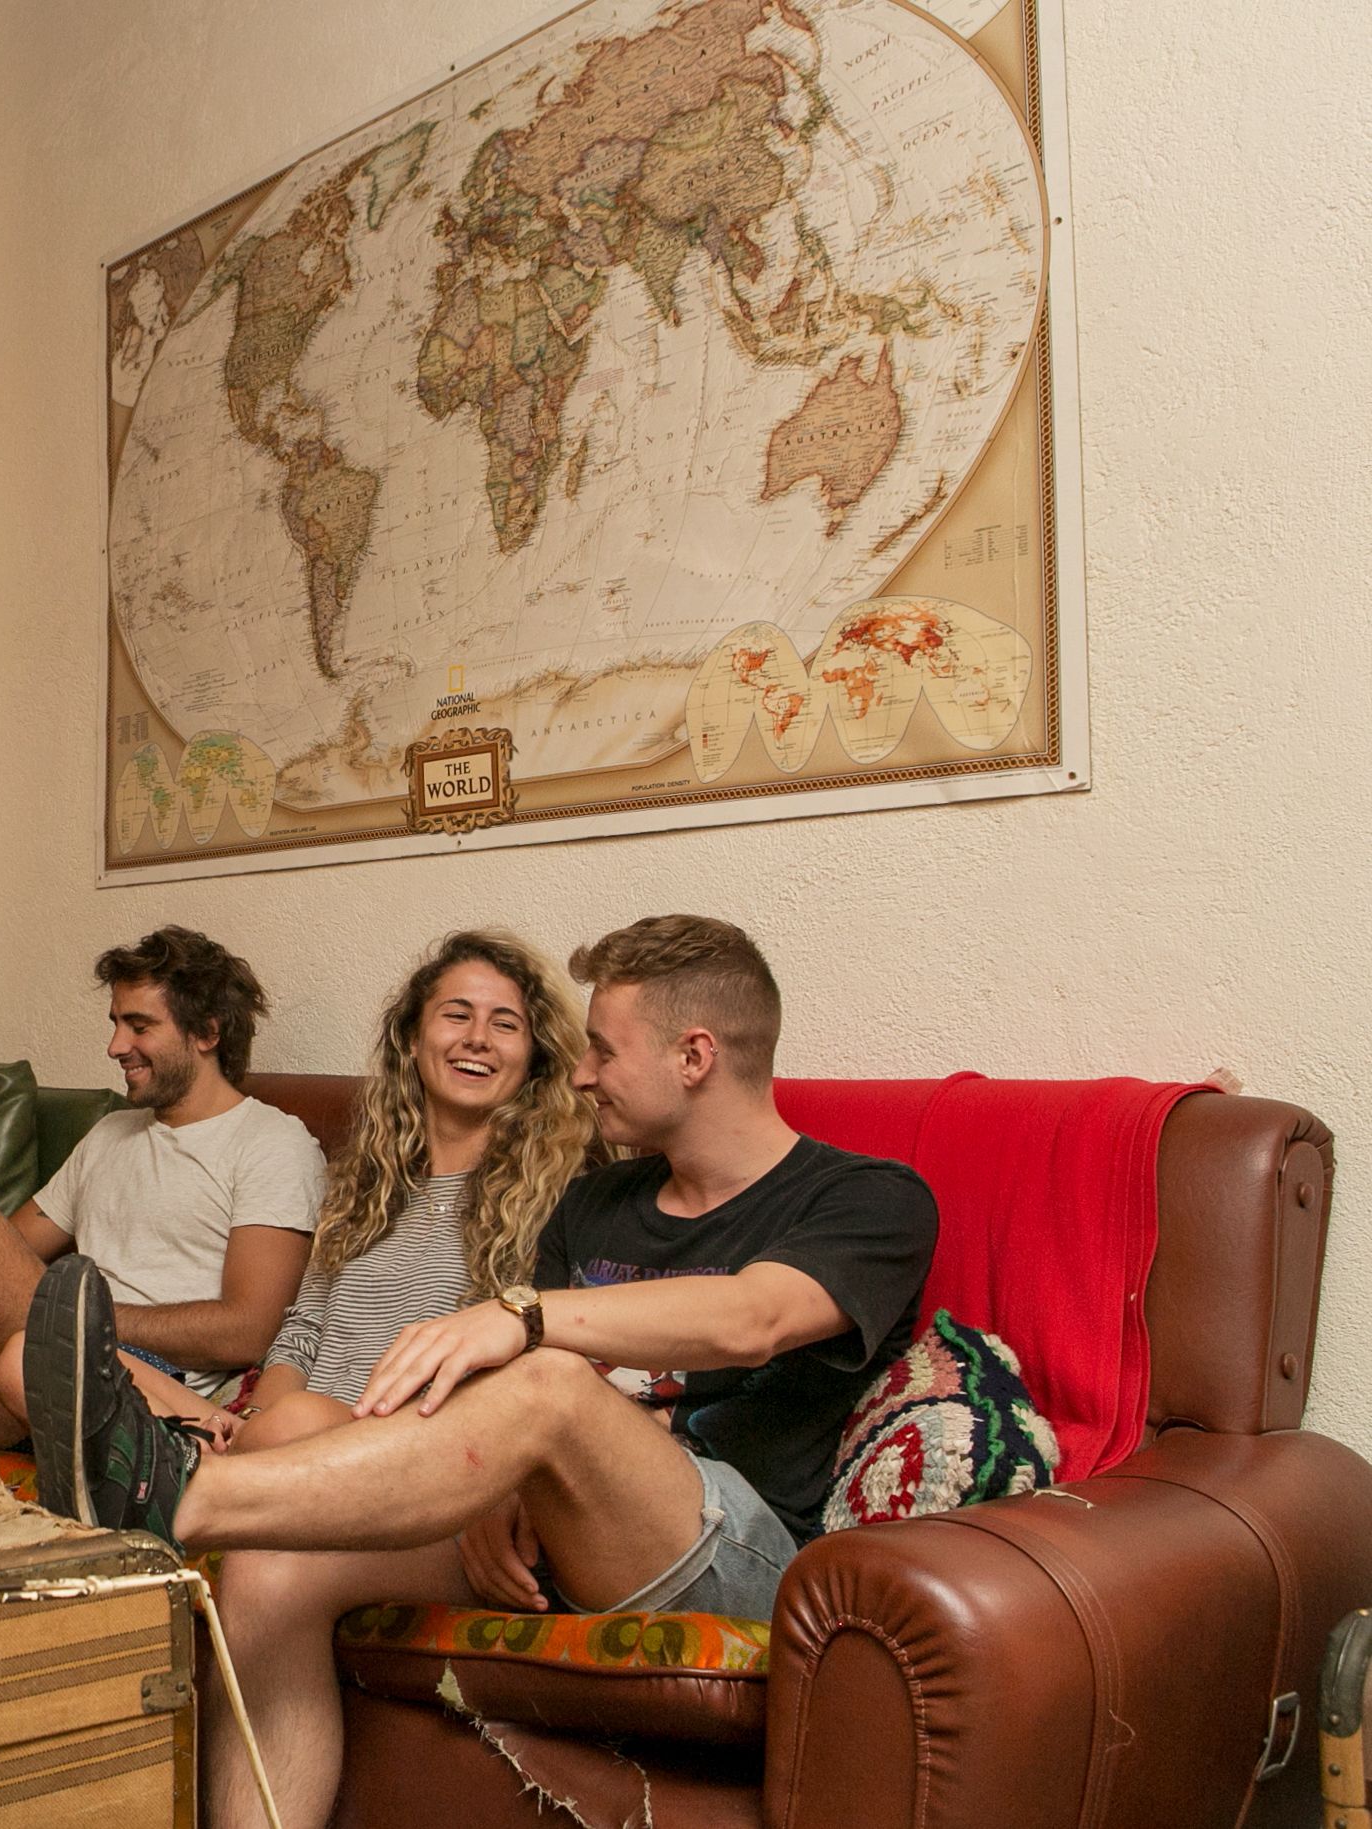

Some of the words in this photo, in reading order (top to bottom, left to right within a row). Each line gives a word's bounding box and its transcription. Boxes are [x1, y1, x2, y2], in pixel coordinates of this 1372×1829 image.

[843, 32, 892, 71] NORTH
[872, 71, 932, 110] PACIFIC
[902, 119, 952, 151] OCEAN
[784, 420, 886, 447] AUSTRALIA
[431, 702, 481, 721] GEOGRAPHIC
[436, 691, 476, 708] NATIONAL
[531, 709, 657, 738] ANTARCTICA
[444, 761, 471, 777] THE
[426, 776, 492, 800] WORLD
[631, 782, 666, 792] POPULATION
[667, 779, 692, 790] DENSITY
